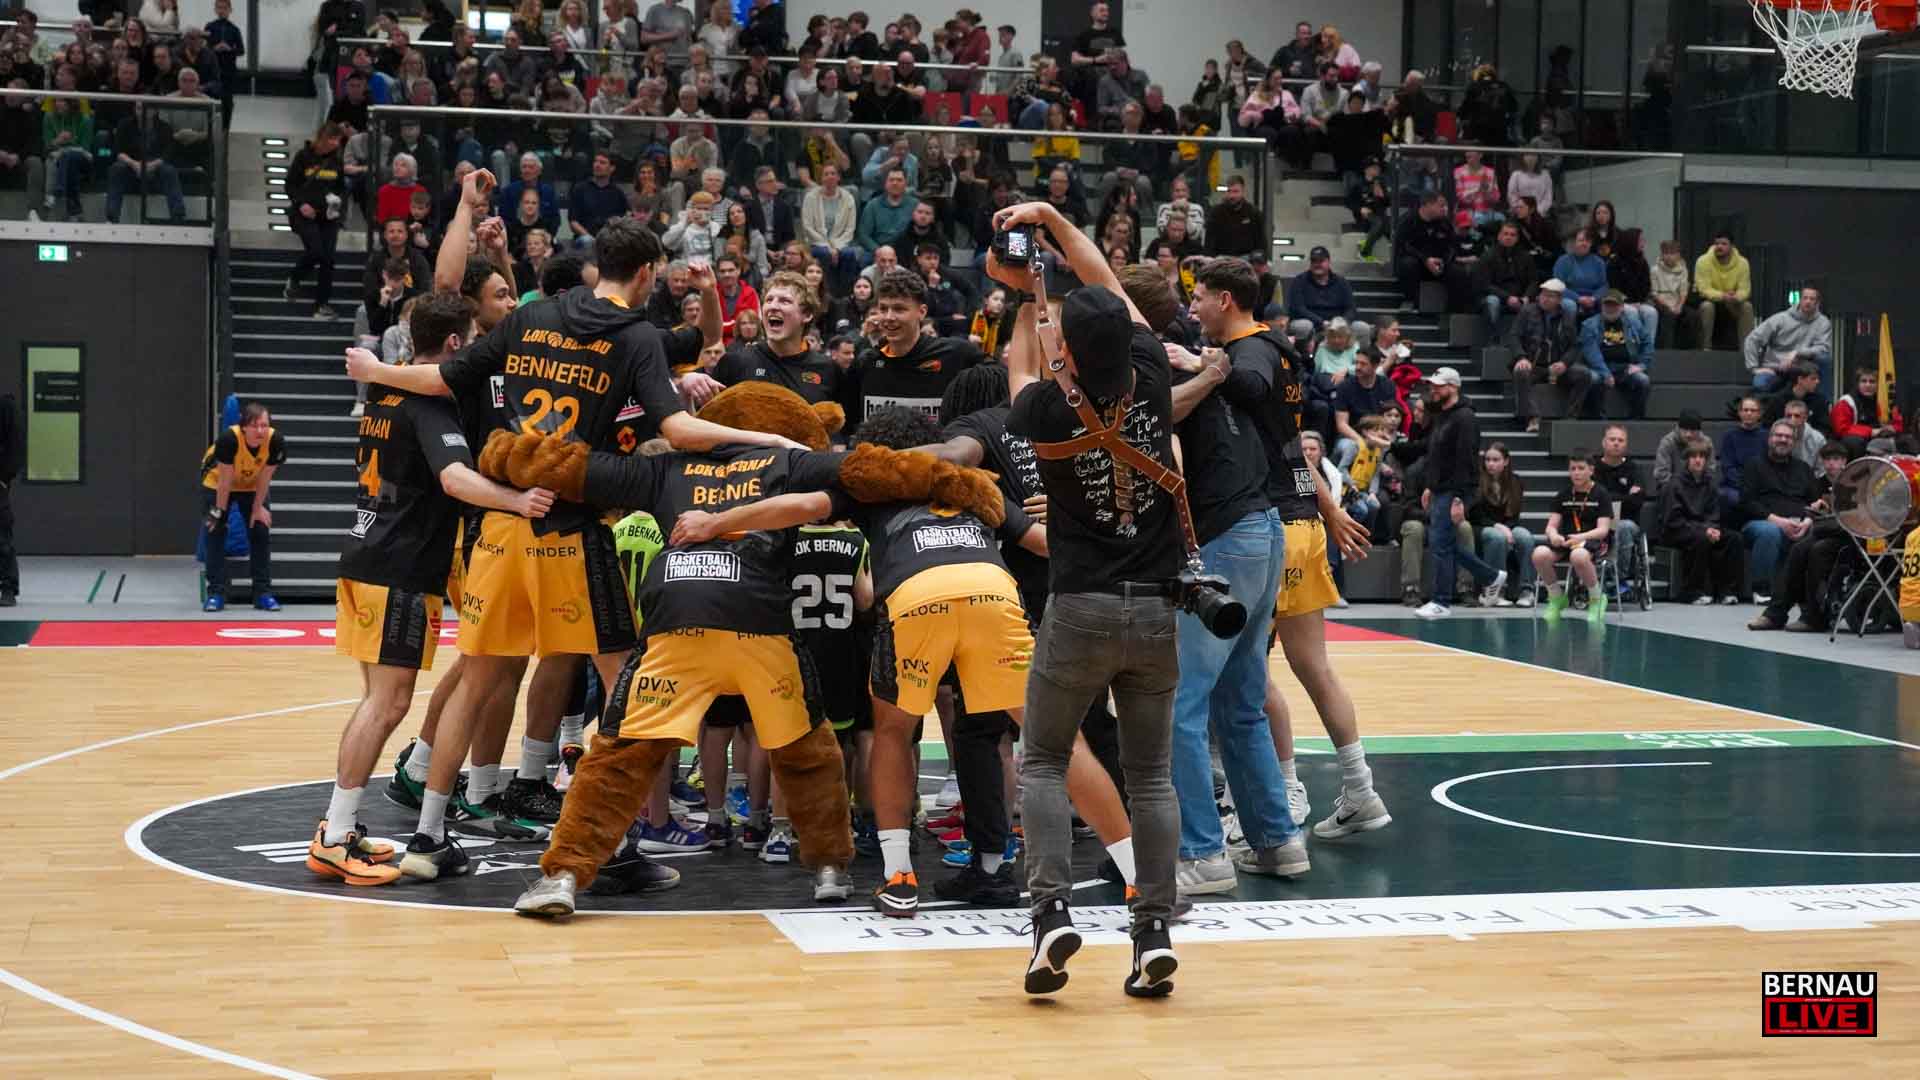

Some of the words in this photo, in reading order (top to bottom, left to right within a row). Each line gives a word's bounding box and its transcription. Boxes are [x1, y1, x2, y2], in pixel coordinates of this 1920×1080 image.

[522, 329, 549, 343] LOK
[561, 337, 613, 354] BEAU
[505, 354, 611, 394] BENNEFELD
[520, 388, 580, 436] 22
[684, 464, 715, 476] LOK
[727, 455, 776, 473] ERNA
[628, 524, 663, 545] BERNAU
[526, 546, 576, 558] FINDER
[669, 554, 731, 566] BASKETBALL
[791, 573, 854, 630] 25
